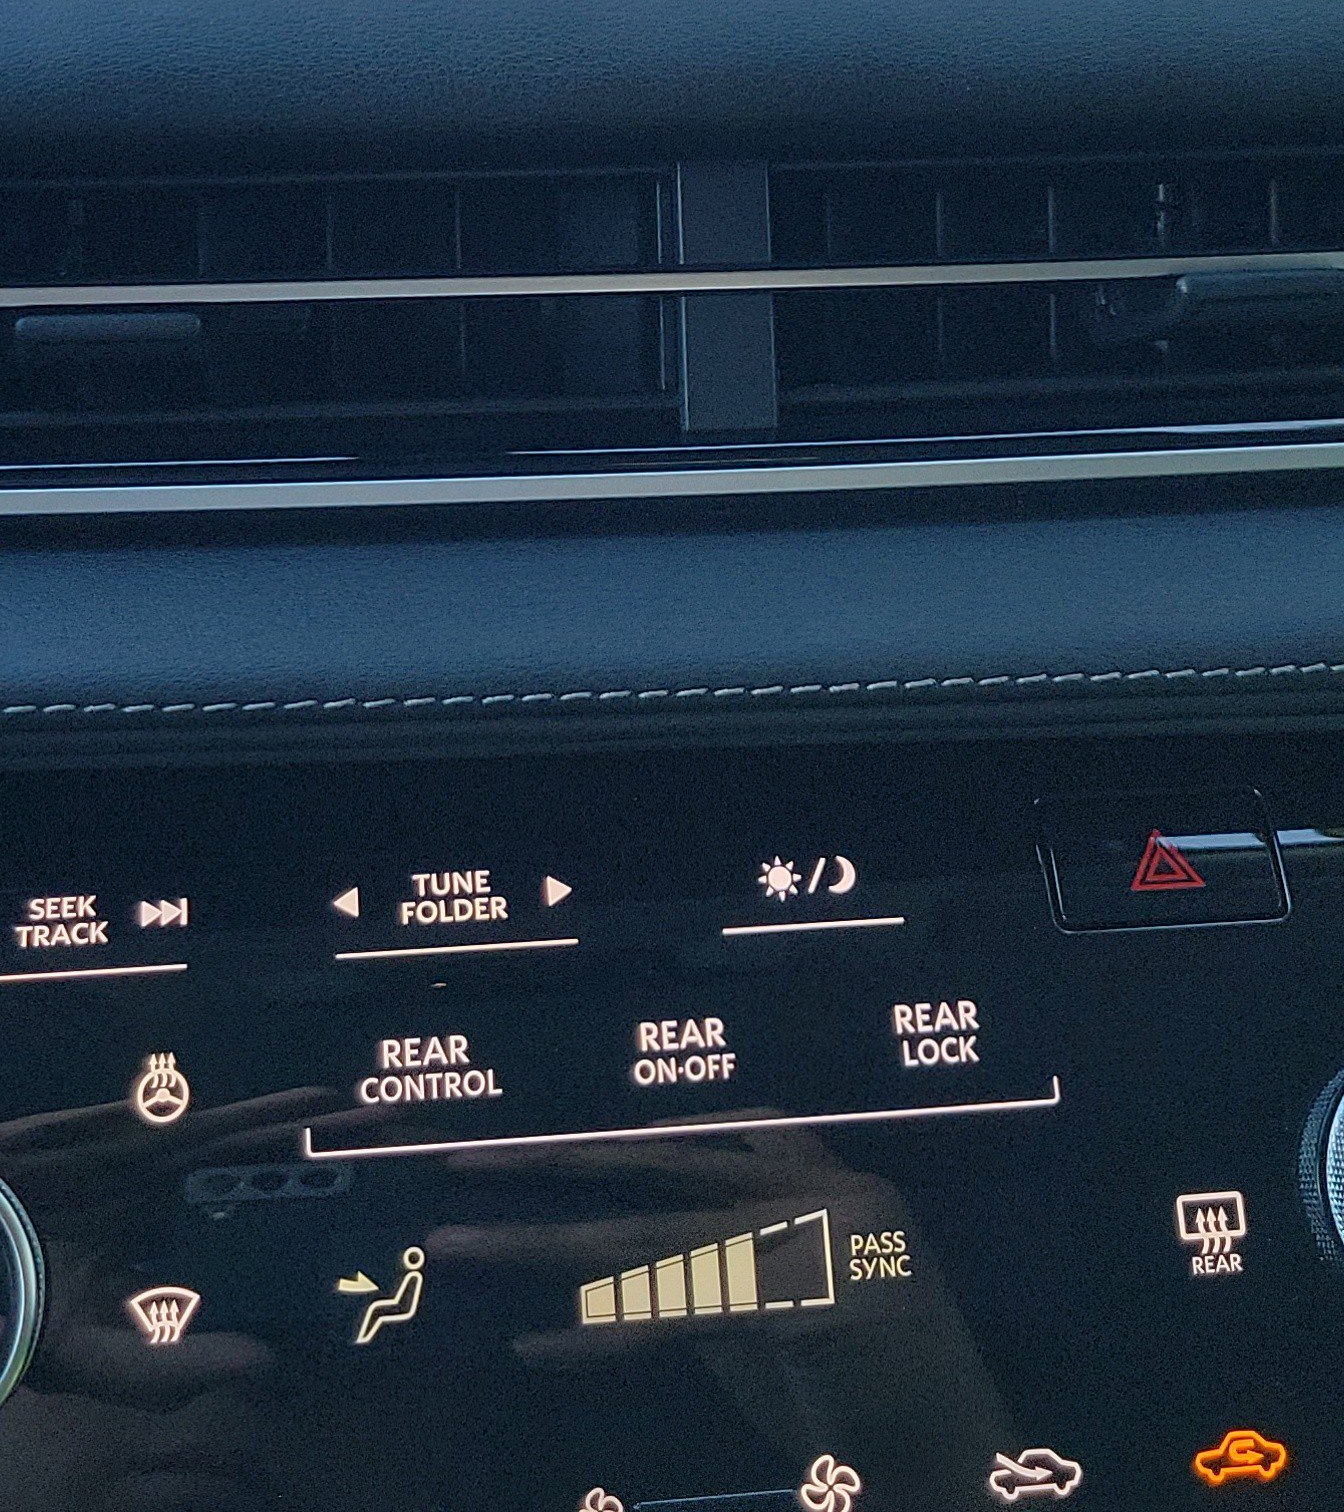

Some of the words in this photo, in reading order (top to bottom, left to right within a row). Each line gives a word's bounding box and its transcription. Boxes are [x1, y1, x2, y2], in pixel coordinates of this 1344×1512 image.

[411, 869, 491, 898] TUNE
[29, 895, 97, 920] SEEK
[401, 895, 509, 926] FOLDER
[16, 920, 109, 947] TRACK
[893, 1000, 979, 1034] REAR
[639, 1017, 726, 1052] REAR
[382, 1035, 470, 1068] REAR
[902, 1035, 980, 1068] LOCK
[360, 1069, 504, 1105] CONTROL
[850, 1230, 907, 1256] PASS
[849, 1254, 913, 1281] SYNC
[1191, 1253, 1244, 1276] REAR
